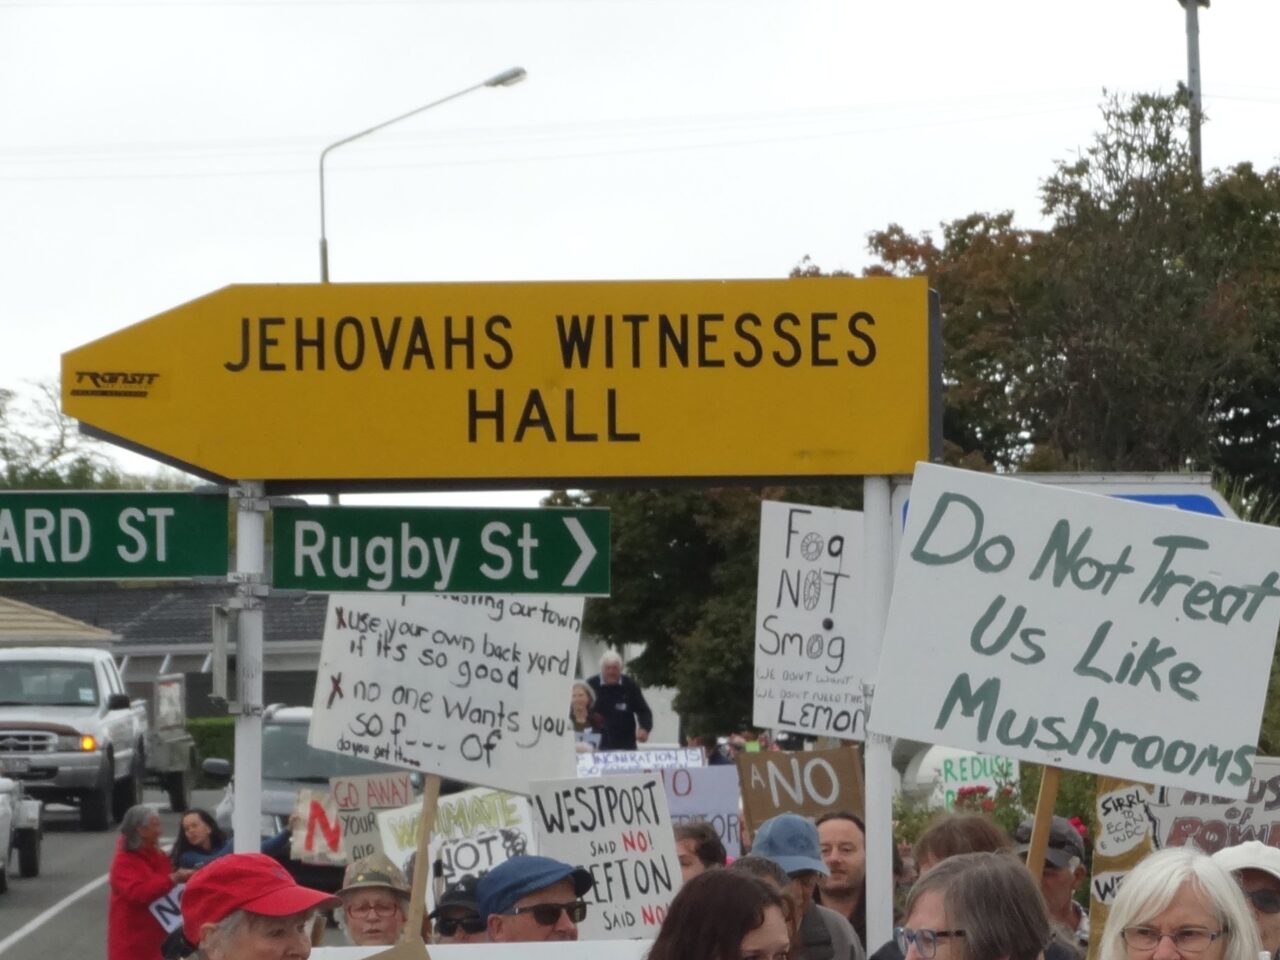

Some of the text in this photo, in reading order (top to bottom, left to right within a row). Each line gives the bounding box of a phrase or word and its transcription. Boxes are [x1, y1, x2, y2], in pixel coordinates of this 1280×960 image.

[224, 310, 878, 373] JEHOVAHS WITNESSES
[467, 387, 642, 443] HALL
[117, 507, 175, 562] ST
[294, 521, 540, 590] Rugby St
[910, 491, 1016, 573] Do
[1028, 519, 1136, 596] Not
[509, 602, 537, 618] our
[540, 602, 581, 633] town
[776, 568, 851, 614] NOT
[349, 636, 367, 655] if
[417, 648, 448, 668] so
[450, 661, 519, 690] good
[386, 618, 429, 643] your
[432, 629, 475, 654] own
[482, 633, 522, 663] back
[528, 650, 570, 676] yard
[759, 614, 846, 674] Smog
[970, 594, 1202, 702] Us Like
[353, 681, 381, 702] no
[391, 686, 433, 714] one
[515, 713, 565, 749] you
[934, 672, 1257, 788] Mushrooms
[334, 775, 411, 807] GO AWAY
[535, 780, 660, 833] WESTPORT
[750, 757, 840, 808] A NO
[1101, 788, 1145, 817] SIRRL
[341, 811, 378, 837] YOUR
[590, 841, 616, 857] SAID
[581, 855, 672, 904] EFTON
[602, 910, 635, 931] SAID
